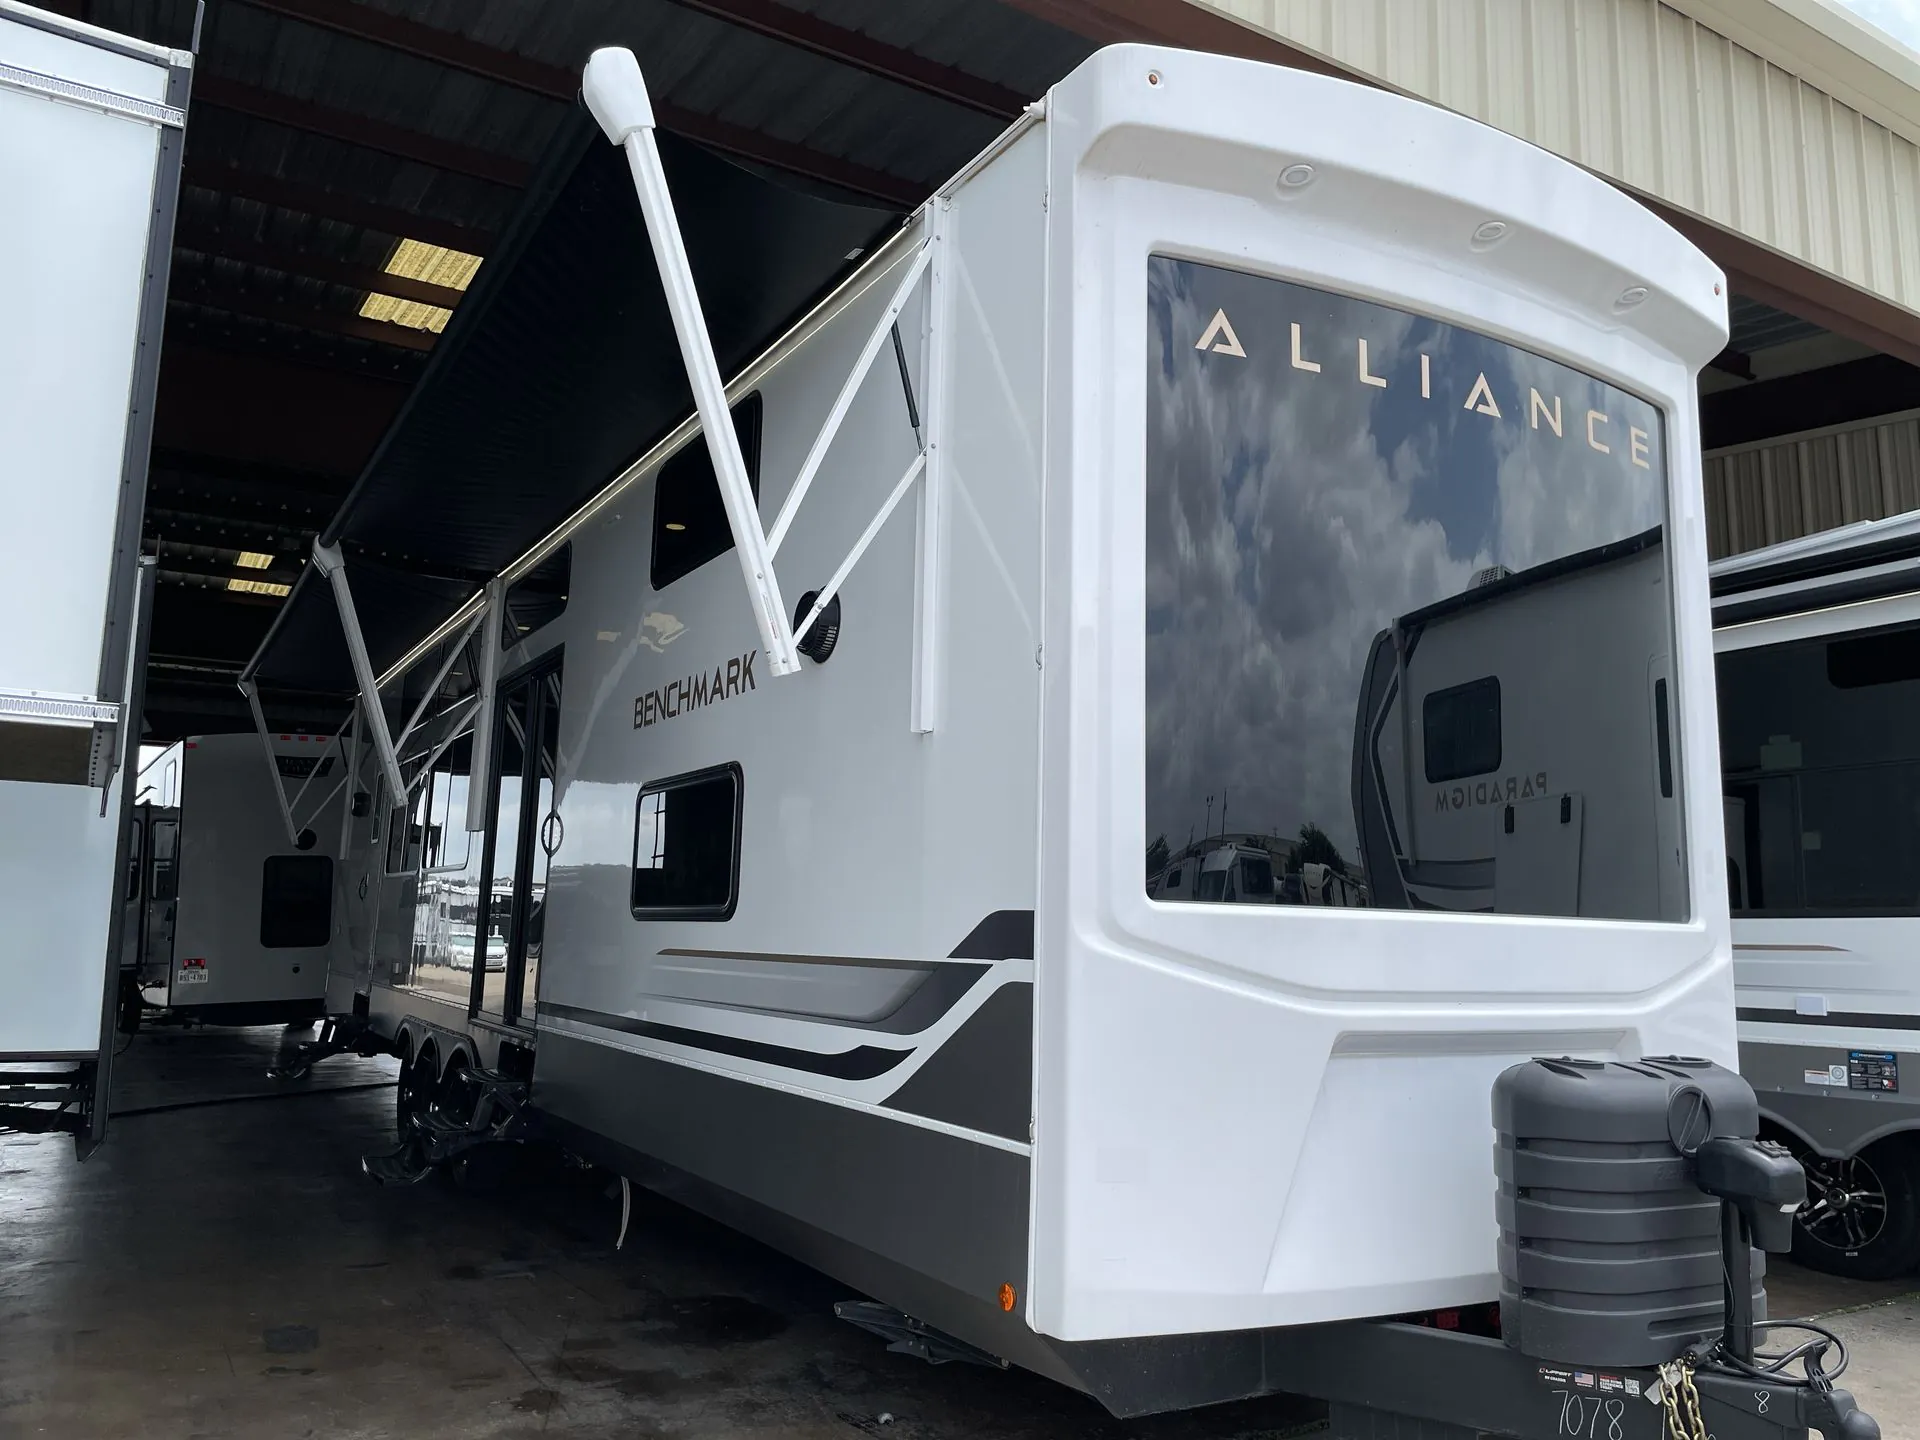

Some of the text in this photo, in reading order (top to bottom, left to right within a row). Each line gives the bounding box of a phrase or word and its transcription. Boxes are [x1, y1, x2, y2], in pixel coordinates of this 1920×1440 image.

[1195, 308, 1650, 469] ALLIANCE
[633, 650, 757, 729] BENCHMARK
[1551, 1390, 1625, 1440] 7078
[1754, 1390, 1770, 1414] 8
